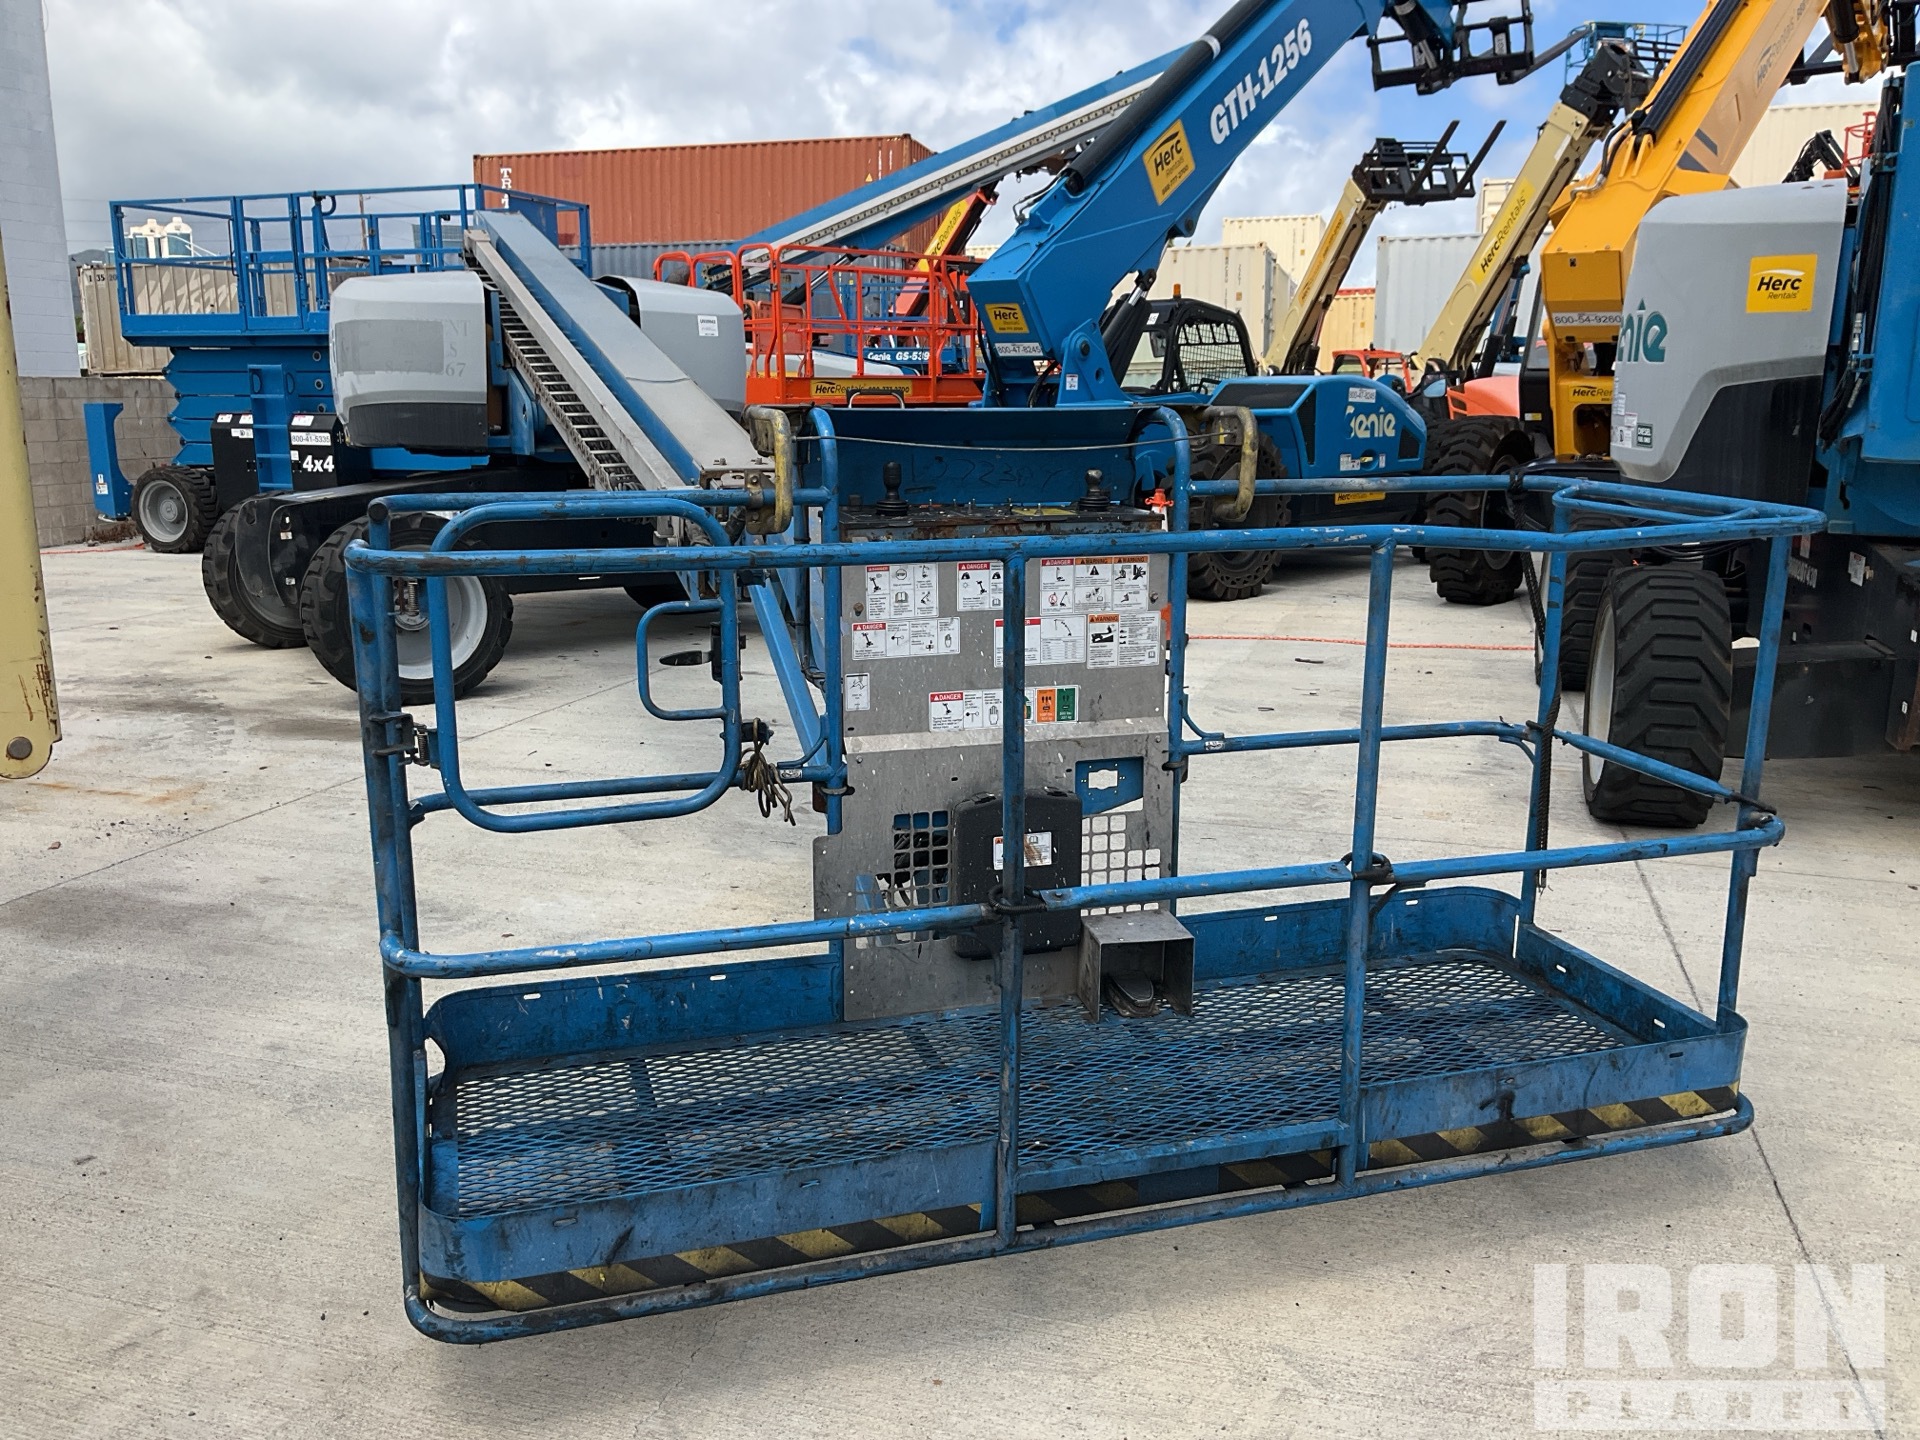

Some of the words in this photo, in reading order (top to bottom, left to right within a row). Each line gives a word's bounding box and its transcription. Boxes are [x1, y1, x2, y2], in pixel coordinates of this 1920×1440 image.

[1210, 18, 1312, 144] GTH-1256
[1154, 139, 1182, 176] Herc
[1480, 194, 1526, 274] HercRentals
[1757, 276, 1803, 291] Herc
[1767, 291, 1800, 300] Rentals
[994, 310, 1019, 320] Herc
[867, 351, 892, 361] Genie
[302, 454, 335, 473] 4x4
[862, 623, 884, 631] DANGER
[938, 693, 962, 701] DANGER
